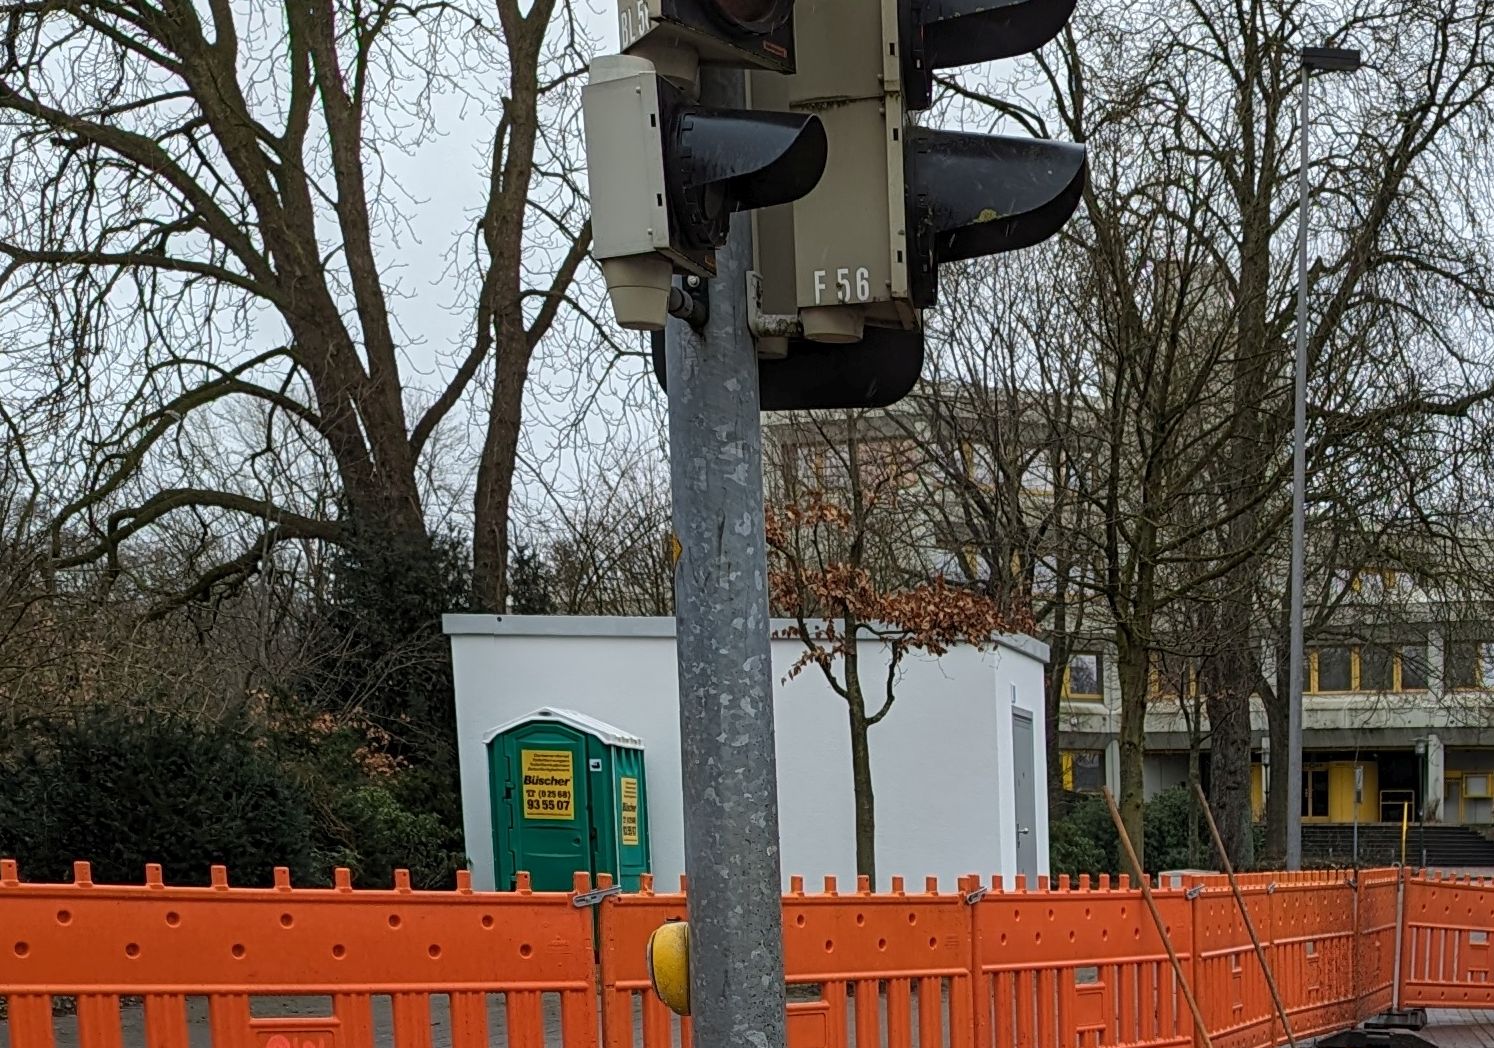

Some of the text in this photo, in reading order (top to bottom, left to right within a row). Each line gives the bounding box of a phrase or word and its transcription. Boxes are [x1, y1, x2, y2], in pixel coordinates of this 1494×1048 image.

[621, 8, 636, 50] BL
[814, 267, 870, 305] F 56
[523, 775, 571, 786] Büscher
[527, 799, 571, 811] 93 55 07
